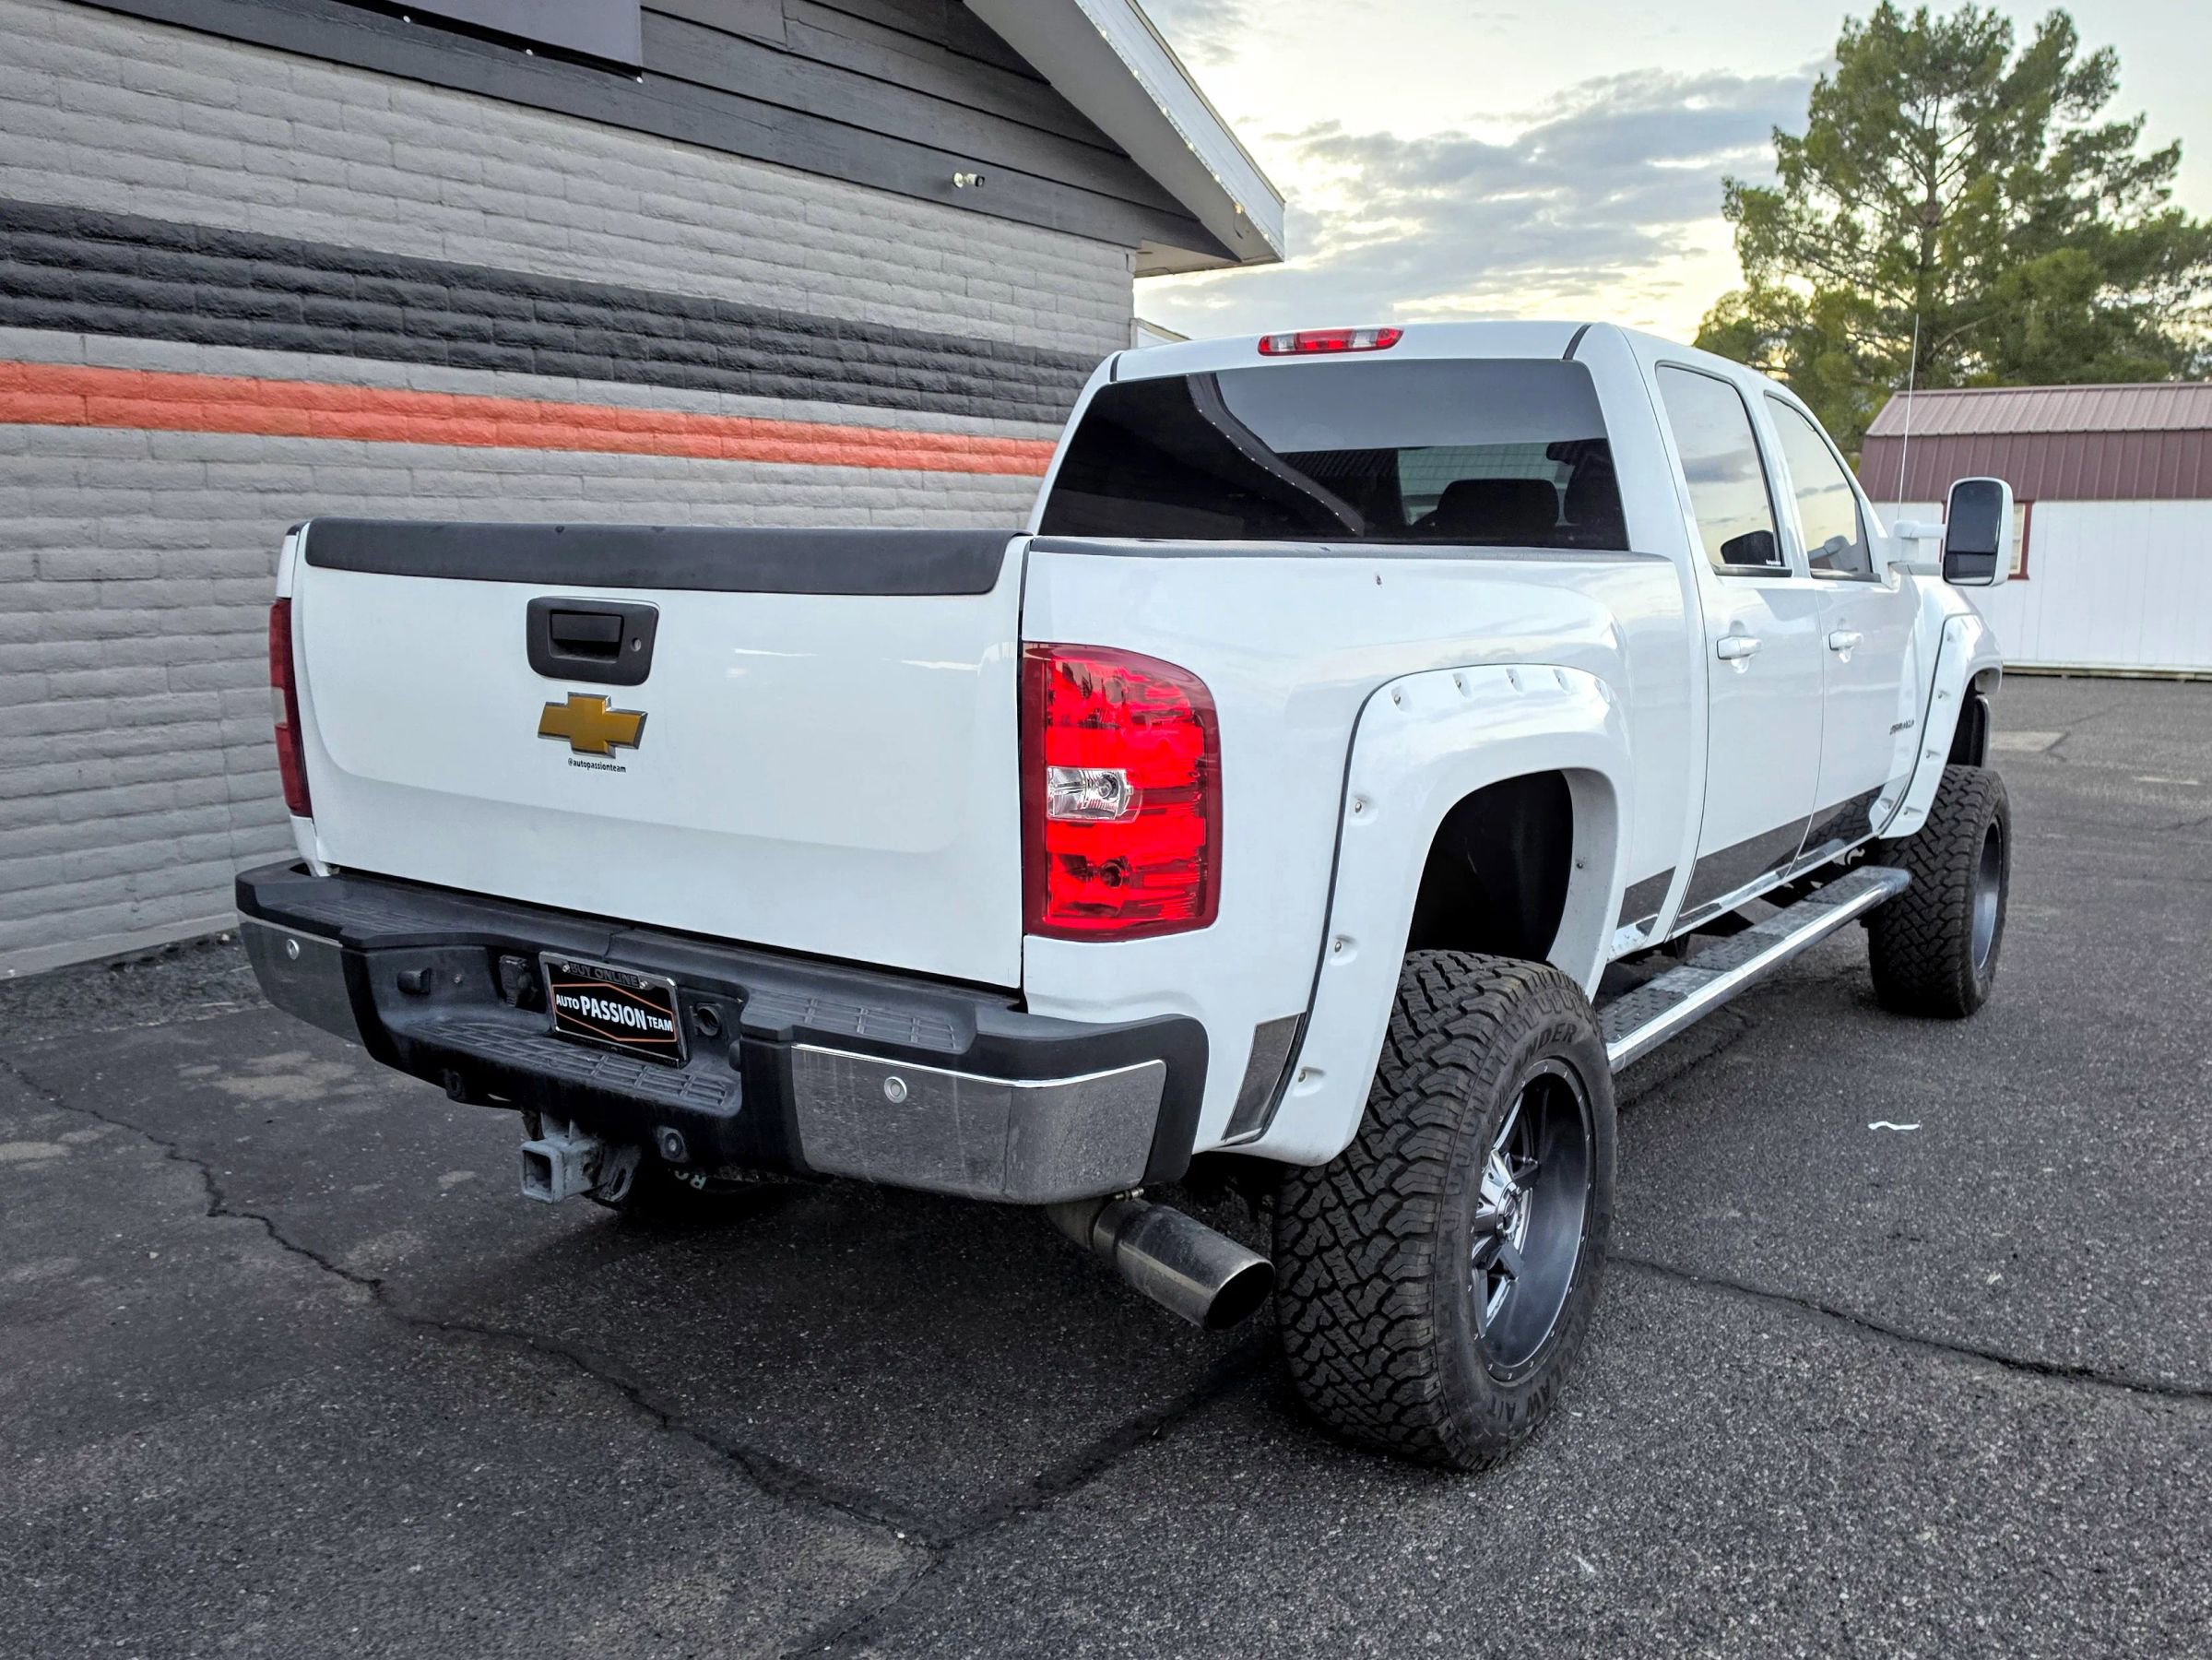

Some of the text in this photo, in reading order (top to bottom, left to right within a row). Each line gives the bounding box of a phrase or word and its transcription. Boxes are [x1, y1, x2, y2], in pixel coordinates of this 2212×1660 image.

[568, 757, 627, 773] @autopassionteam
[569, 962, 639, 986] BUY ONLINE
[556, 994, 673, 1033] AUTO PASSION TEAM
